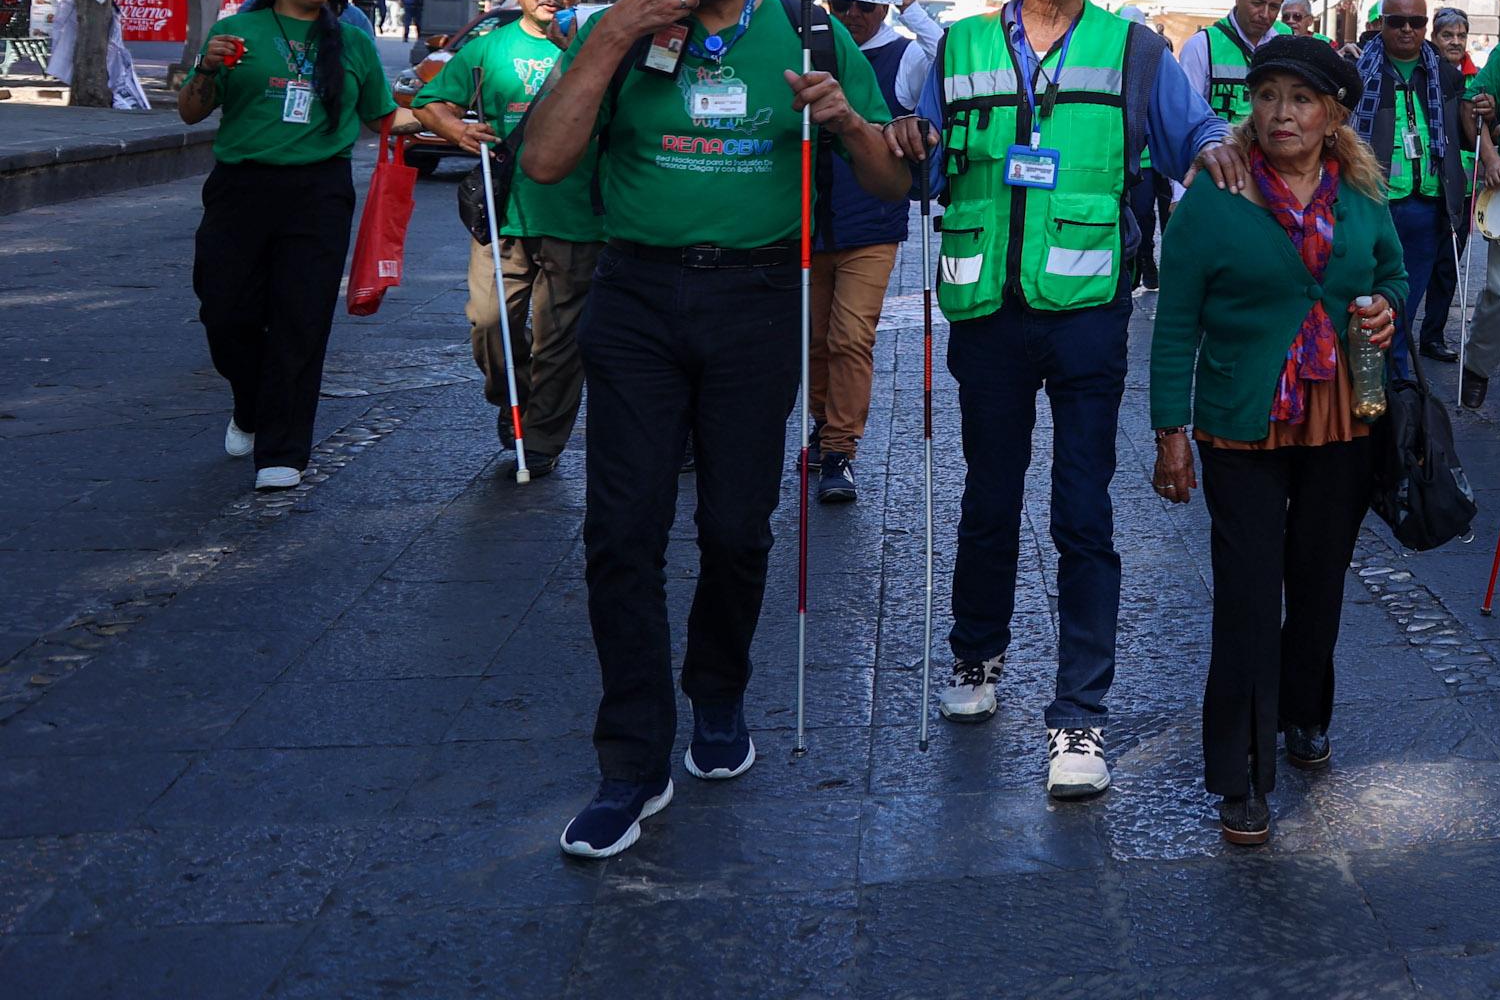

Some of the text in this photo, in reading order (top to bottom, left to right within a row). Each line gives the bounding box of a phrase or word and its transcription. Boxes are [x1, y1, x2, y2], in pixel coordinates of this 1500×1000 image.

[120, 5, 169, 19] vierno
[662, 135, 773, 155] RENACBVI
[672, 156, 704, 165] Nacional
[706, 159, 724, 167] para
